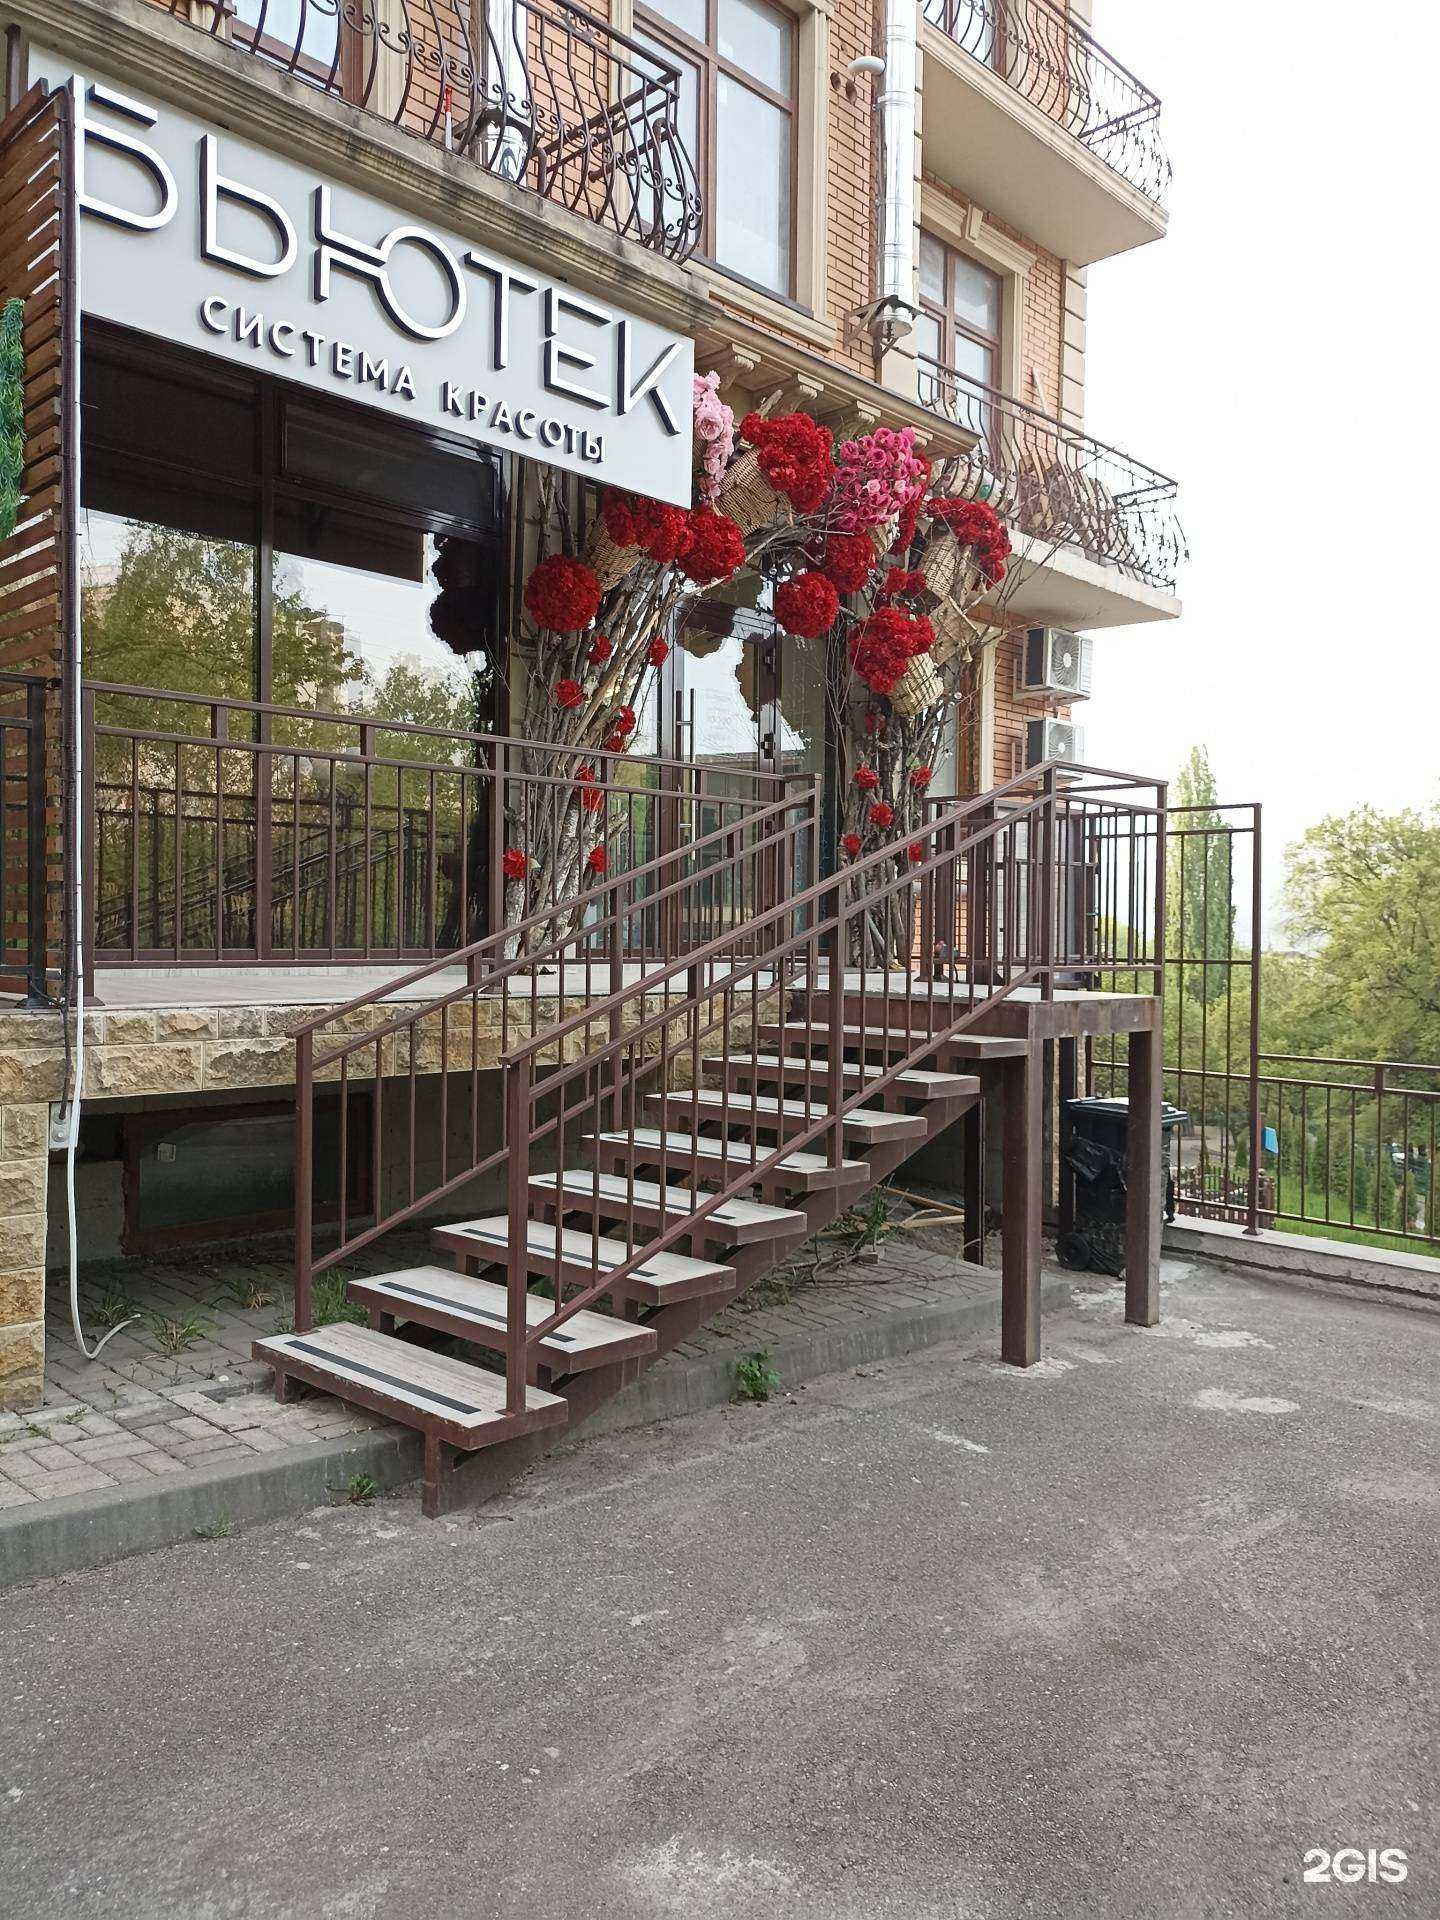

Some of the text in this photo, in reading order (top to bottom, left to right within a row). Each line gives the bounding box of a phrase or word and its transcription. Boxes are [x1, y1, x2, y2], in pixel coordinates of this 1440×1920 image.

[69, 74, 685, 436] БЬЮТЕК
[200, 296, 606, 463] СИСТЕМА КРАСОТЫ
